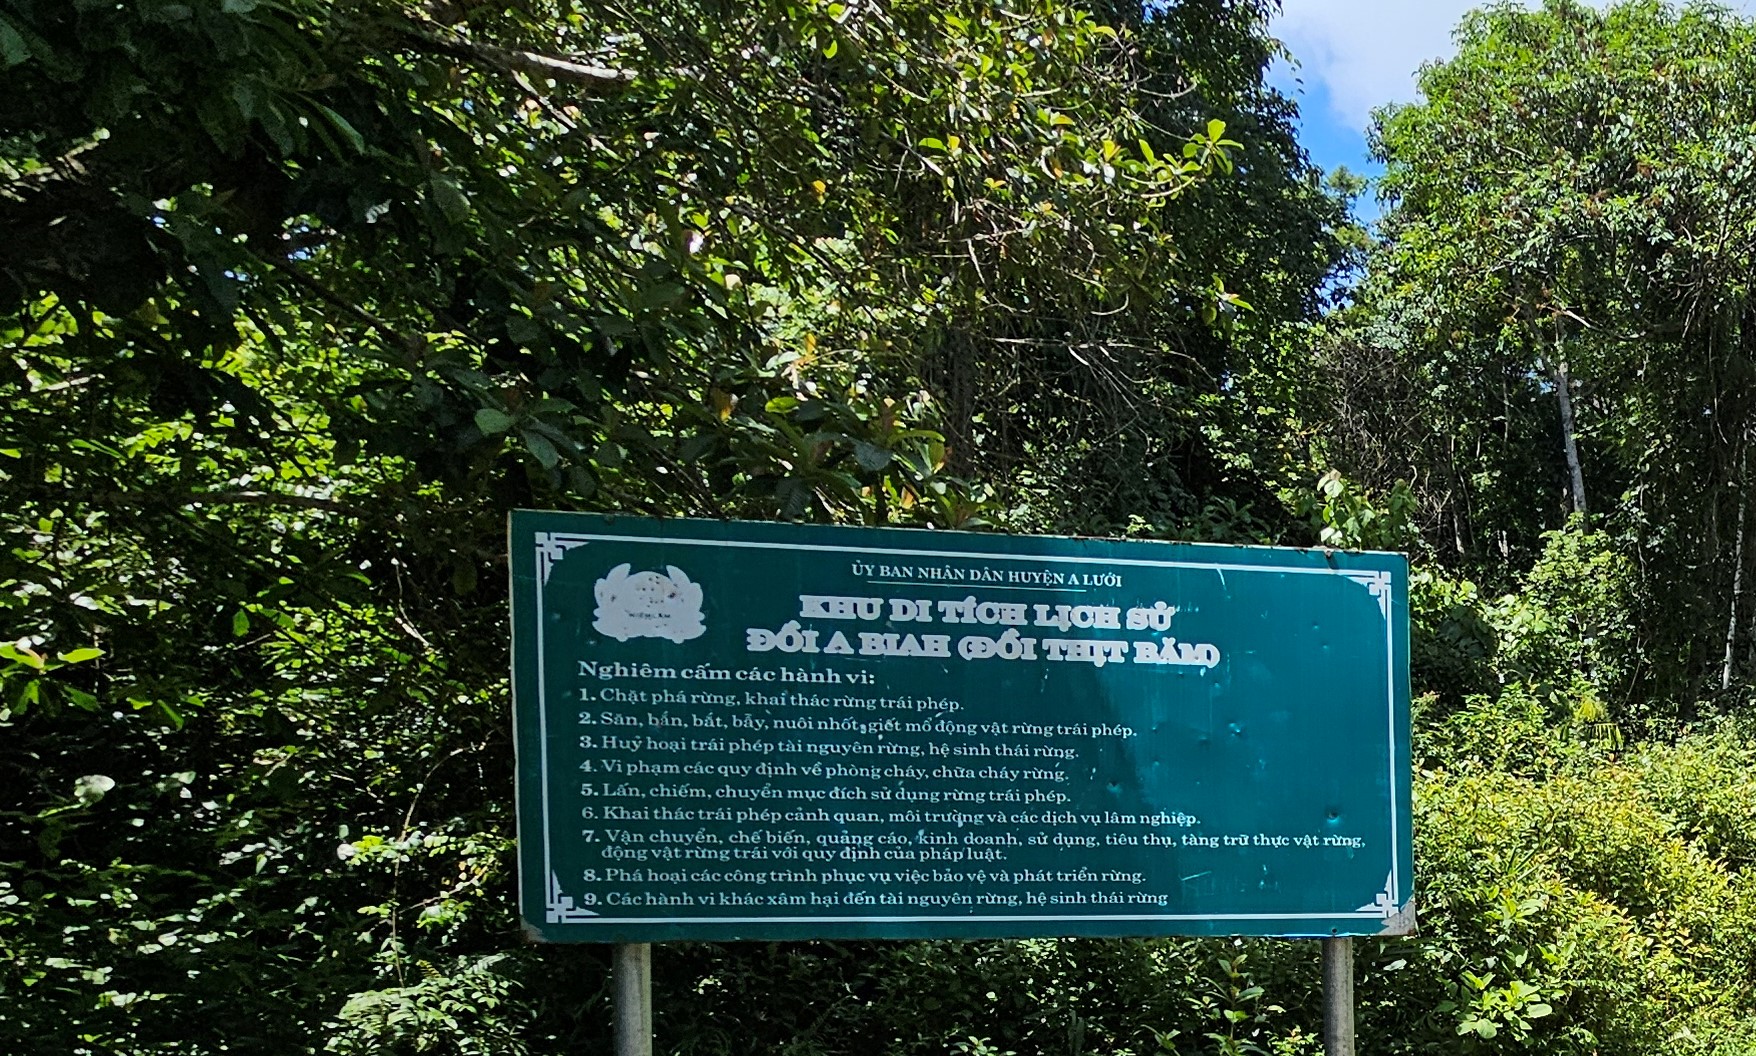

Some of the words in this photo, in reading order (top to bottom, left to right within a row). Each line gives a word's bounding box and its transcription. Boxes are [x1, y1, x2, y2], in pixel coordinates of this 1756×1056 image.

[879, 564, 913, 578] BAN
[917, 564, 965, 580] NHÂN
[969, 566, 1004, 582] DÂN
[1007, 569, 1065, 586] HUYỆN
[1067, 573, 1080, 585] A
[1082, 571, 1122, 588] LƯỚI
[798, 594, 884, 621] KHU
[888, 598, 933, 623] DI
[937, 595, 1028, 625] TÍCH
[1032, 599, 1121, 631] LỊCH
[745, 622, 821, 653] ĐỒI
[823, 630, 855, 655] A
[857, 631, 952, 658] BIAH
[1041, 638, 1129, 668] THỊT
[577, 660, 677, 680] Nghiêm
[680, 662, 731, 680] cấm
[735, 666, 776, 681] các
[779, 666, 842, 684] hành
[845, 669, 875, 685] vi:
[579, 687, 596, 701] 1.
[600, 687, 647, 705] Chặt
[651, 689, 687, 705] phá
[690, 690, 740, 707] rừng,
[744, 691, 786, 706] khai
[789, 692, 830, 707] thác
[833, 694, 876, 710] rừng
[879, 695, 913, 709] trái
[916, 696, 964, 714] phép.
[578, 711, 597, 725] 2.
[600, 711, 643, 727] Săn,
[773, 716, 814, 730] nuôi
[934, 716, 978, 736] động
[980, 721, 1009, 737] vật
[1011, 721, 1054, 738] rừng
[1056, 722, 1088, 736] trái
[1091, 722, 1137, 739] phép.
[579, 735, 598, 748] 3.
[601, 735, 643, 752] Huỷ
[646, 736, 686, 753] hoại
[690, 737, 724, 751] trái
[728, 738, 774, 755] phép
[777, 739, 802, 752] tài
[806, 741, 874, 756] nguyên
[877, 737, 925, 757] rừng,
[928, 741, 950, 758] hệ
[953, 742, 991, 756] sinh
[994, 743, 1030, 757] thái
[1033, 744, 1079, 760] rừng.
[578, 759, 597, 772] 4.
[601, 758, 622, 773] Vi
[626, 759, 680, 776] phạm
[683, 761, 714, 774] các
[717, 764, 752, 777] quy
[755, 761, 797, 778] định
[800, 761, 822, 776] về
[825, 763, 882, 780] phòng
[883, 764, 929, 780] cháy,
[932, 764, 975, 779] chữa
[978, 765, 1020, 782] cháy
[1022, 764, 1069, 782] rừng.
[583, 892, 602, 905] 9.
[606, 892, 642, 905] Các
[645, 891, 695, 905] hành
[697, 891, 715, 905] vi
[718, 891, 764, 906] khác
[766, 892, 806, 905] xâm
[809, 891, 840, 908] hại
[843, 890, 876, 905] đến
[879, 891, 904, 904] tài
[907, 892, 973, 908] nguyên
[976, 891, 1023, 907] rừng,
[1025, 891, 1047, 907] hệ
[1049, 891, 1087, 904] sinh
[1090, 890, 1125, 904] thái
[1127, 891, 1168, 906] rừng
